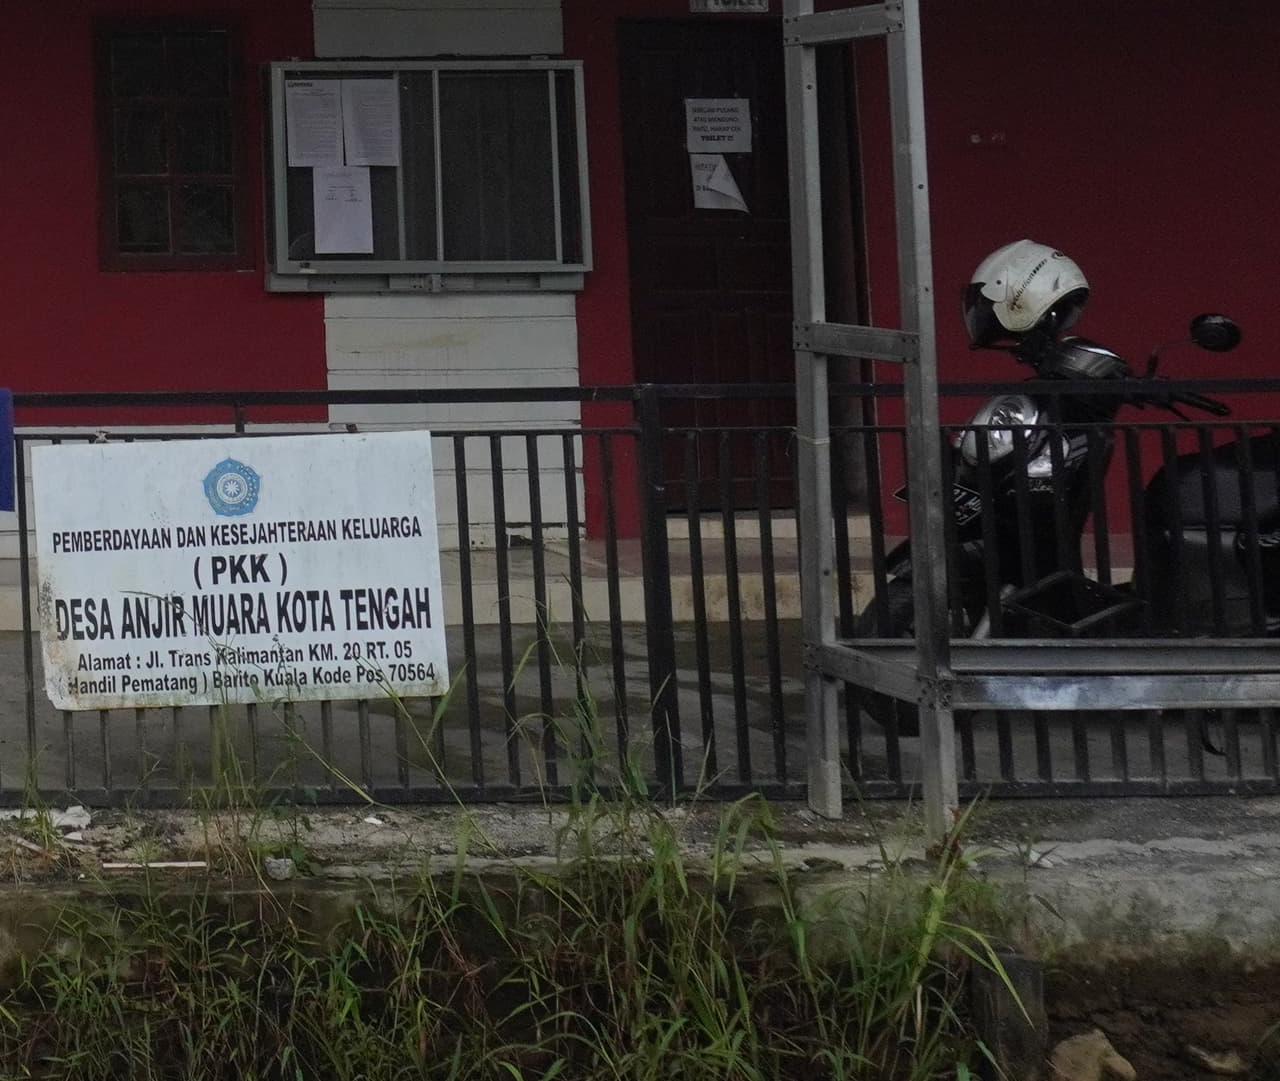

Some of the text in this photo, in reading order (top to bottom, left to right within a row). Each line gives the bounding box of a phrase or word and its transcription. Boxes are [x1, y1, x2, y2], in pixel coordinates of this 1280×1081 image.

[52, 516, 422, 553] PEMBERDAYAAN DAN KESEJAHTERAAN KELUARGA
[212, 555, 270, 584] PKK
[55, 587, 431, 641] DESA ANJIR MUARA KOTA TENGAH
[78, 653, 132, 671] Alamat
[145, 652, 164, 668] Jl.
[168, 649, 211, 667] Trans
[215, 645, 303, 665] Kalimantan
[309, 644, 337, 662] KM.
[343, 643, 360, 660] 20
[366, 641, 391, 659] RT.
[394, 641, 412, 658] 05
[122, 672, 197, 694] Pematang
[213, 669, 259, 688] Barito
[264, 667, 307, 686] Kuala
[312, 665, 352, 684] Kode
[356, 664, 385, 682] Pos
[388, 662, 435, 682] 70564
